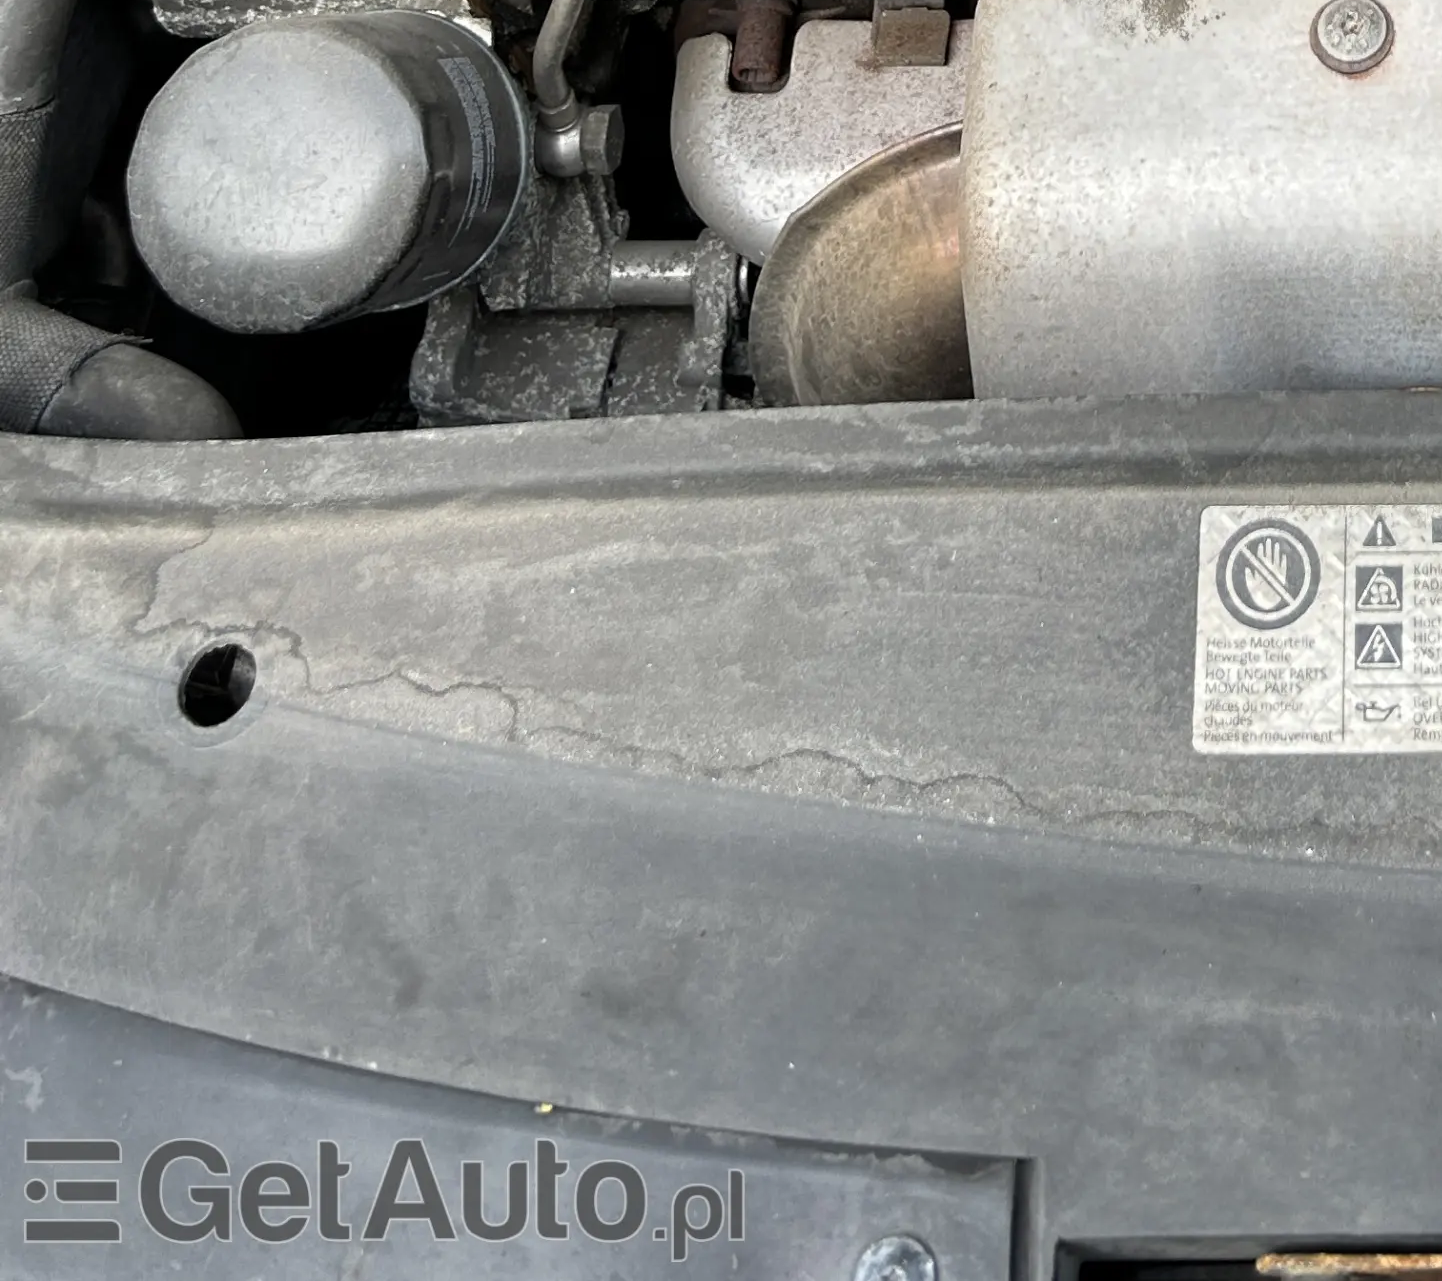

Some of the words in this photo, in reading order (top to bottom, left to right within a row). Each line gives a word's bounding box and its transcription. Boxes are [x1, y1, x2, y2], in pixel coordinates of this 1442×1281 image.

[1413, 594, 1426, 606] Le
[1206, 637, 1246, 649] Heisse
[1250, 636, 1316, 649] Motorteile
[1206, 650, 1261, 665] Bewegte
[1264, 650, 1292, 663] Teile
[1205, 668, 1231, 680] HOT
[1237, 668, 1287, 680] ENGINE
[1290, 667, 1328, 681] PARTS
[1205, 682, 1260, 695] MOVING
[1265, 681, 1304, 695] PARTS
[1242, 698, 1257, 713] du
[1260, 700, 1304, 712] moteur
[1413, 696, 1432, 708] Bei
[1204, 713, 1253, 727] chaudes
[1242, 731, 1257, 742] en
[1258, 730, 1333, 742] mouvement
